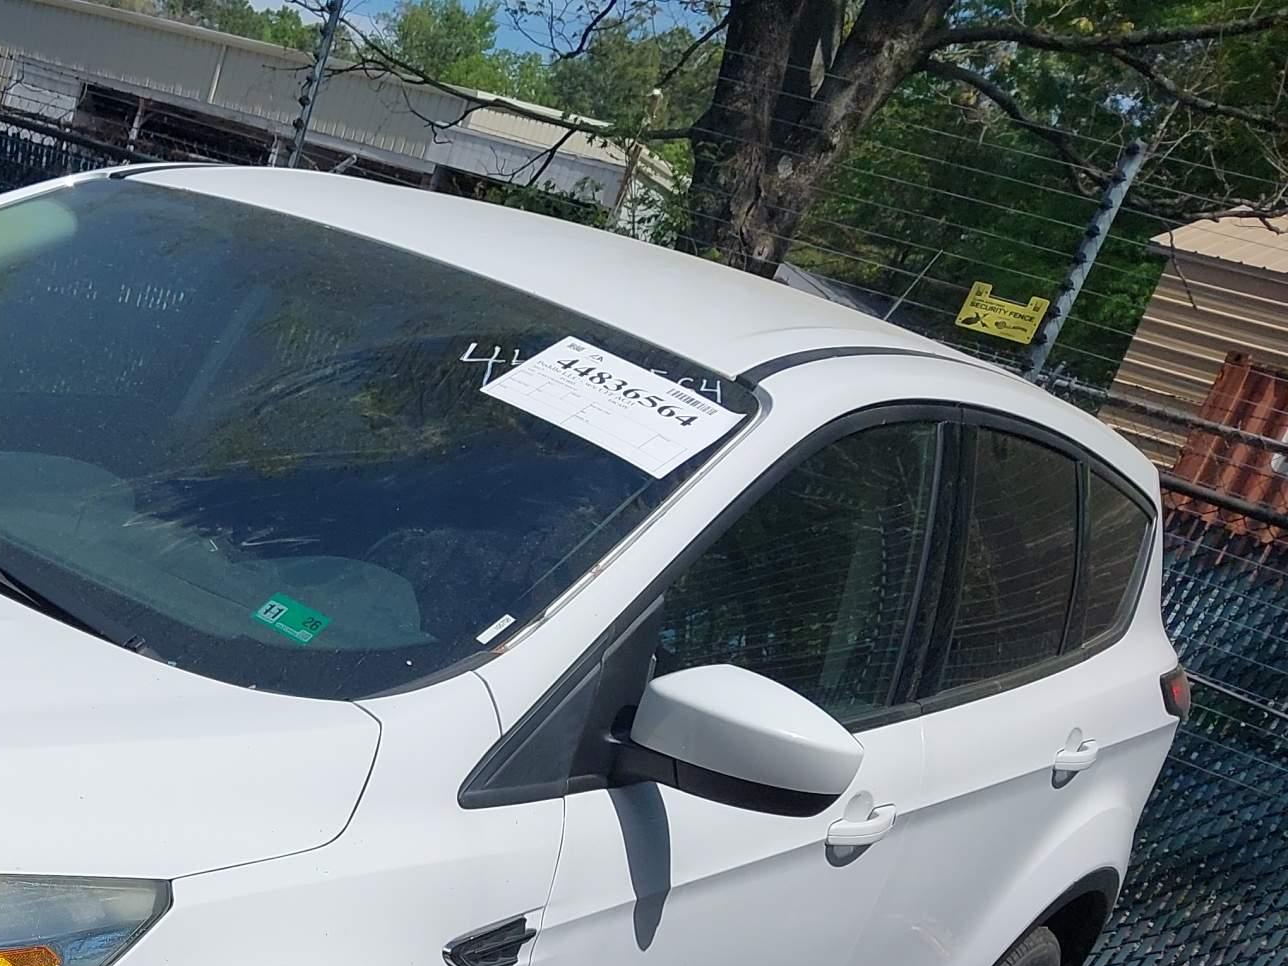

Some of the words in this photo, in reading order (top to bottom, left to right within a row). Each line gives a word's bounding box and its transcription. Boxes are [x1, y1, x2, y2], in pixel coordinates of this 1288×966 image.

[969, 301, 1009, 314] SECURITY
[1008, 311, 1035, 322] FENCE
[557, 359, 698, 426] 44836564
[263, 603, 285, 619] 11
[302, 617, 322, 631] 26
